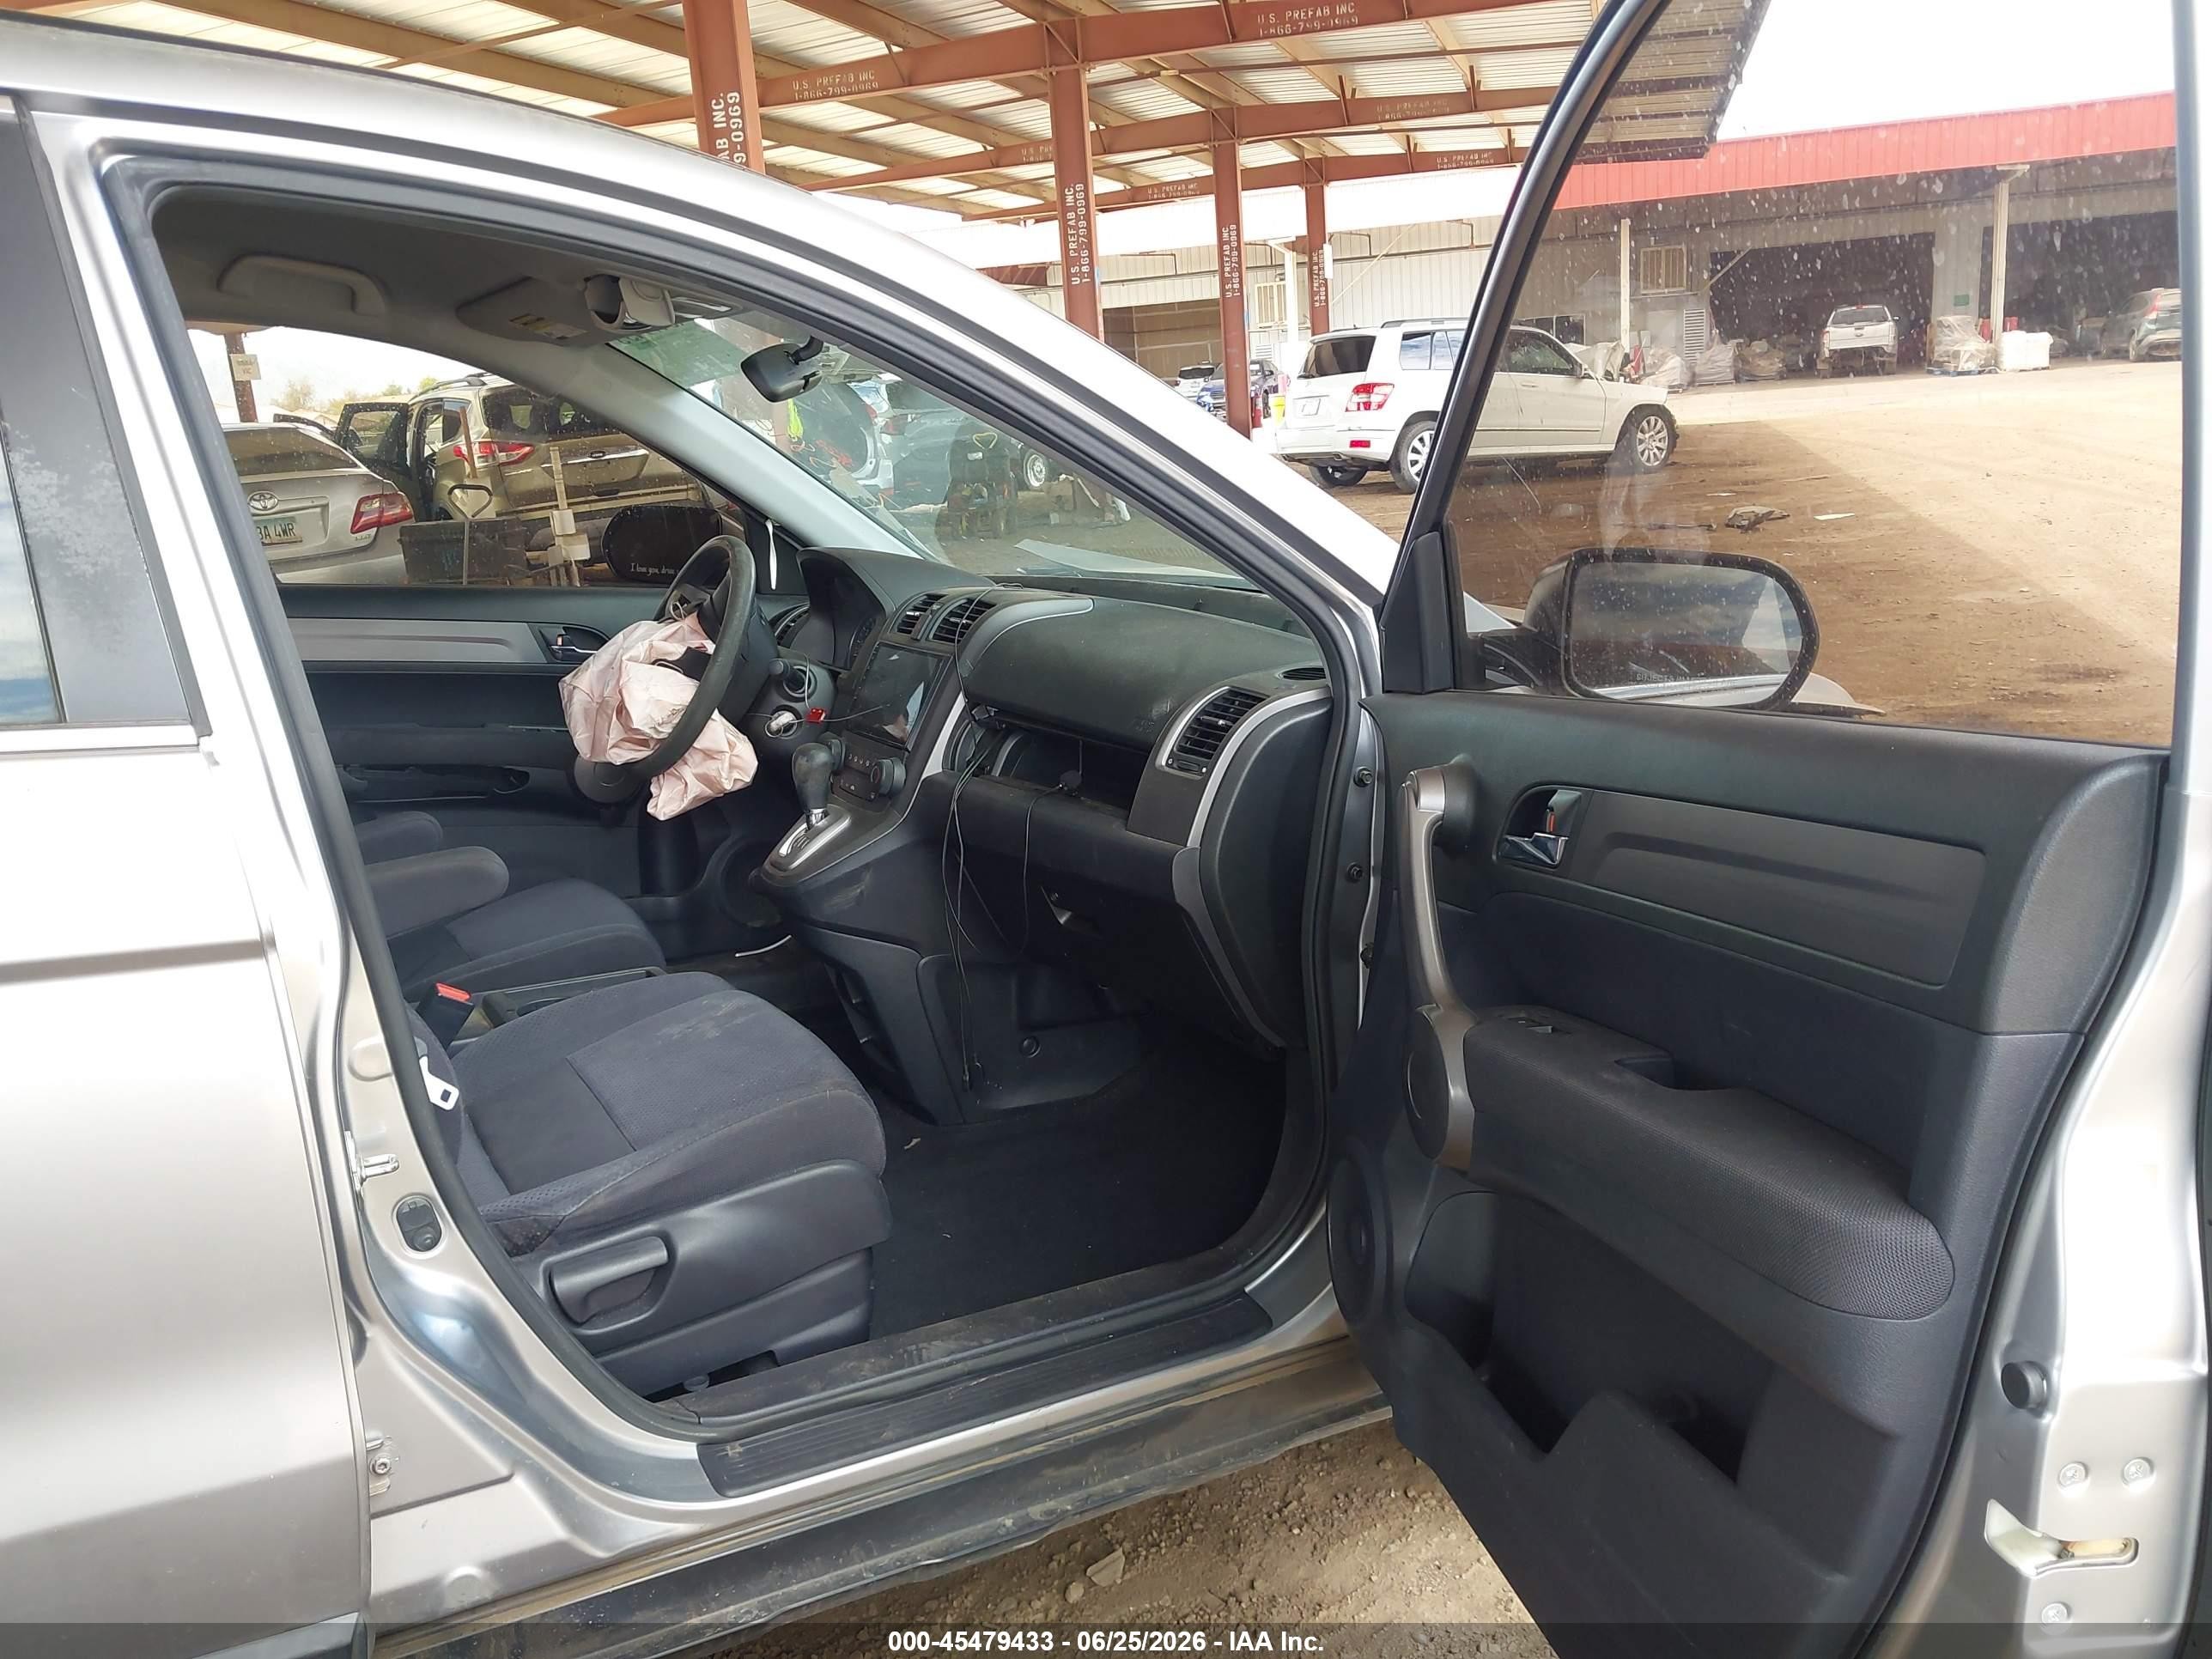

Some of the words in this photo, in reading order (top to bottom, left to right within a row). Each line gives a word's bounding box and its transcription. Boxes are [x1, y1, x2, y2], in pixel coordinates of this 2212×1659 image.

[1285, 5, 1331, 21] PREFAB
[1335, 2, 1355, 15] INC
[711, 92, 727, 129] INC.
[1066, 211, 1079, 257] PREFAB
[1075, 183, 1091, 283] 1-866-799-0969
[1071, 261, 1080, 285] U.S.
[1223, 245, 1231, 277] PREFAB
[274, 522, 296, 538] 4WR
